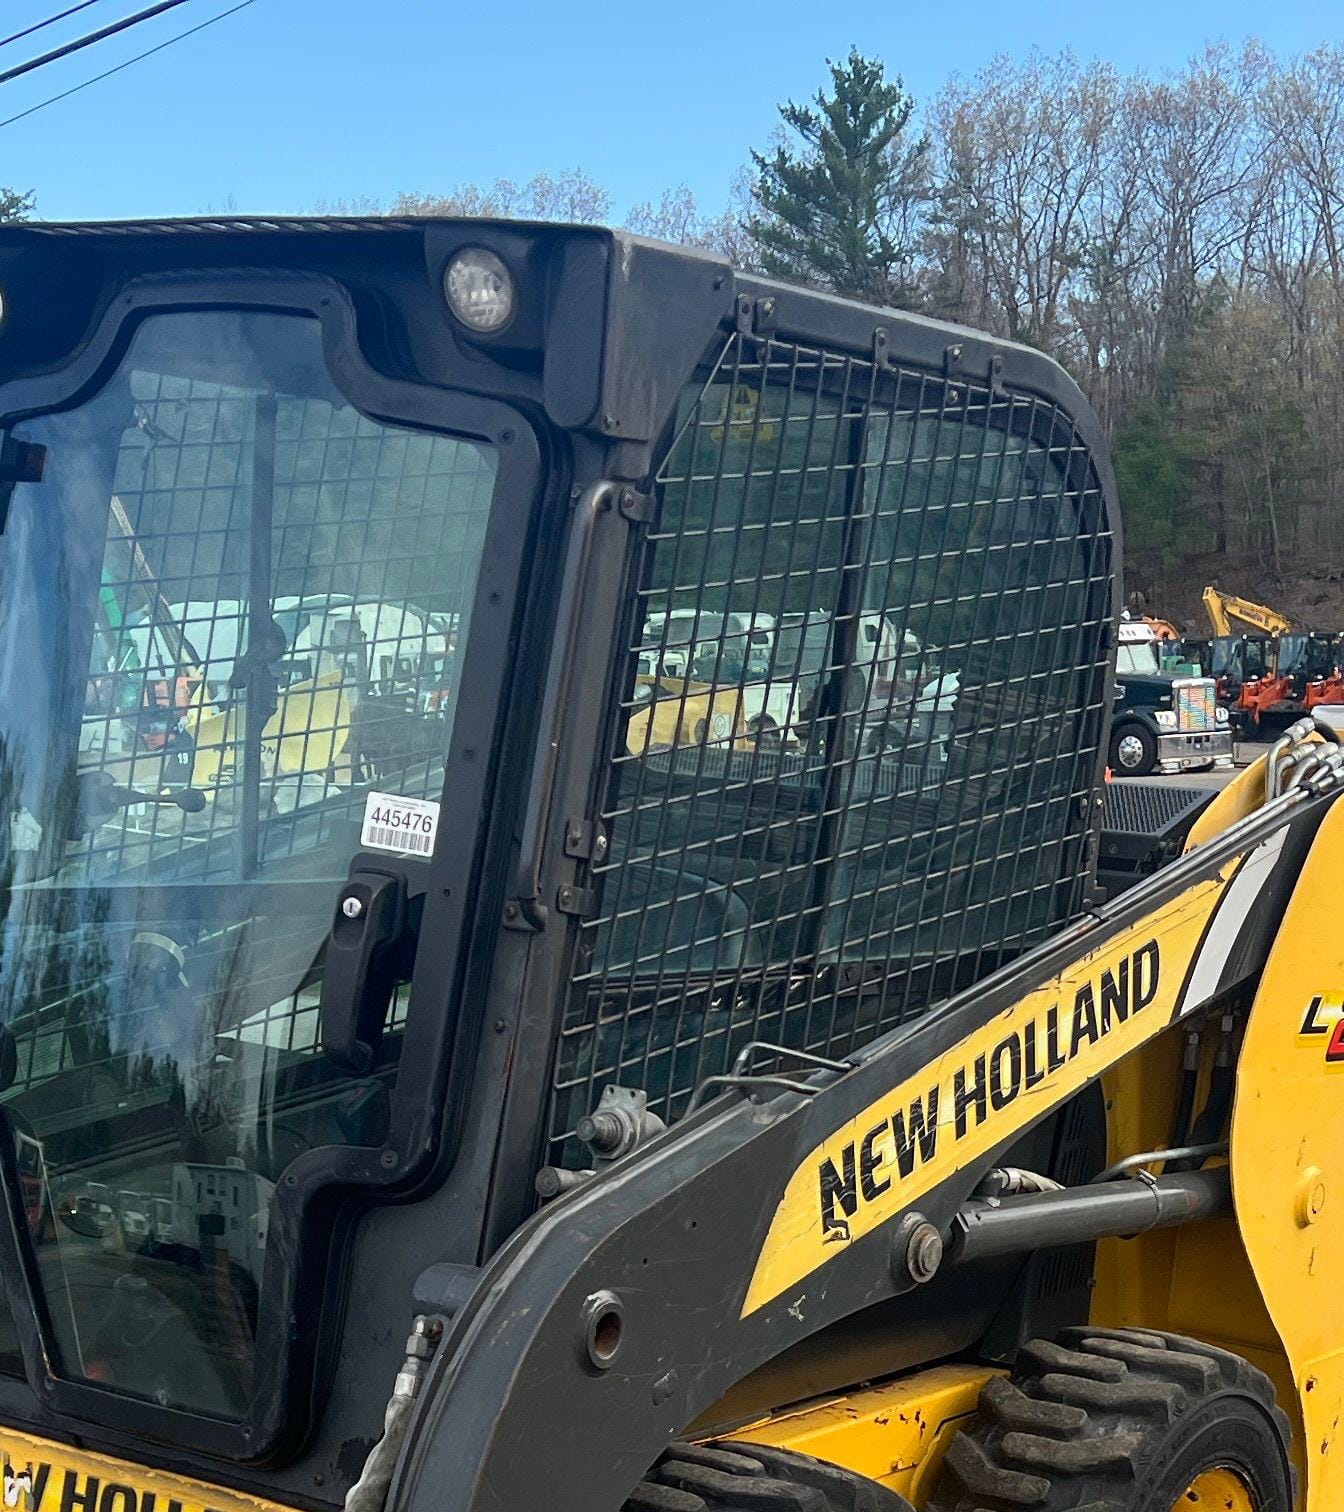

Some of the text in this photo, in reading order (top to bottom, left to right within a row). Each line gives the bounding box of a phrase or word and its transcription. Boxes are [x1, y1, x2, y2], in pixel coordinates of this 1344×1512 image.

[371, 807, 433, 833] 445476
[819, 938, 1162, 1243] NEW HOLLAND
